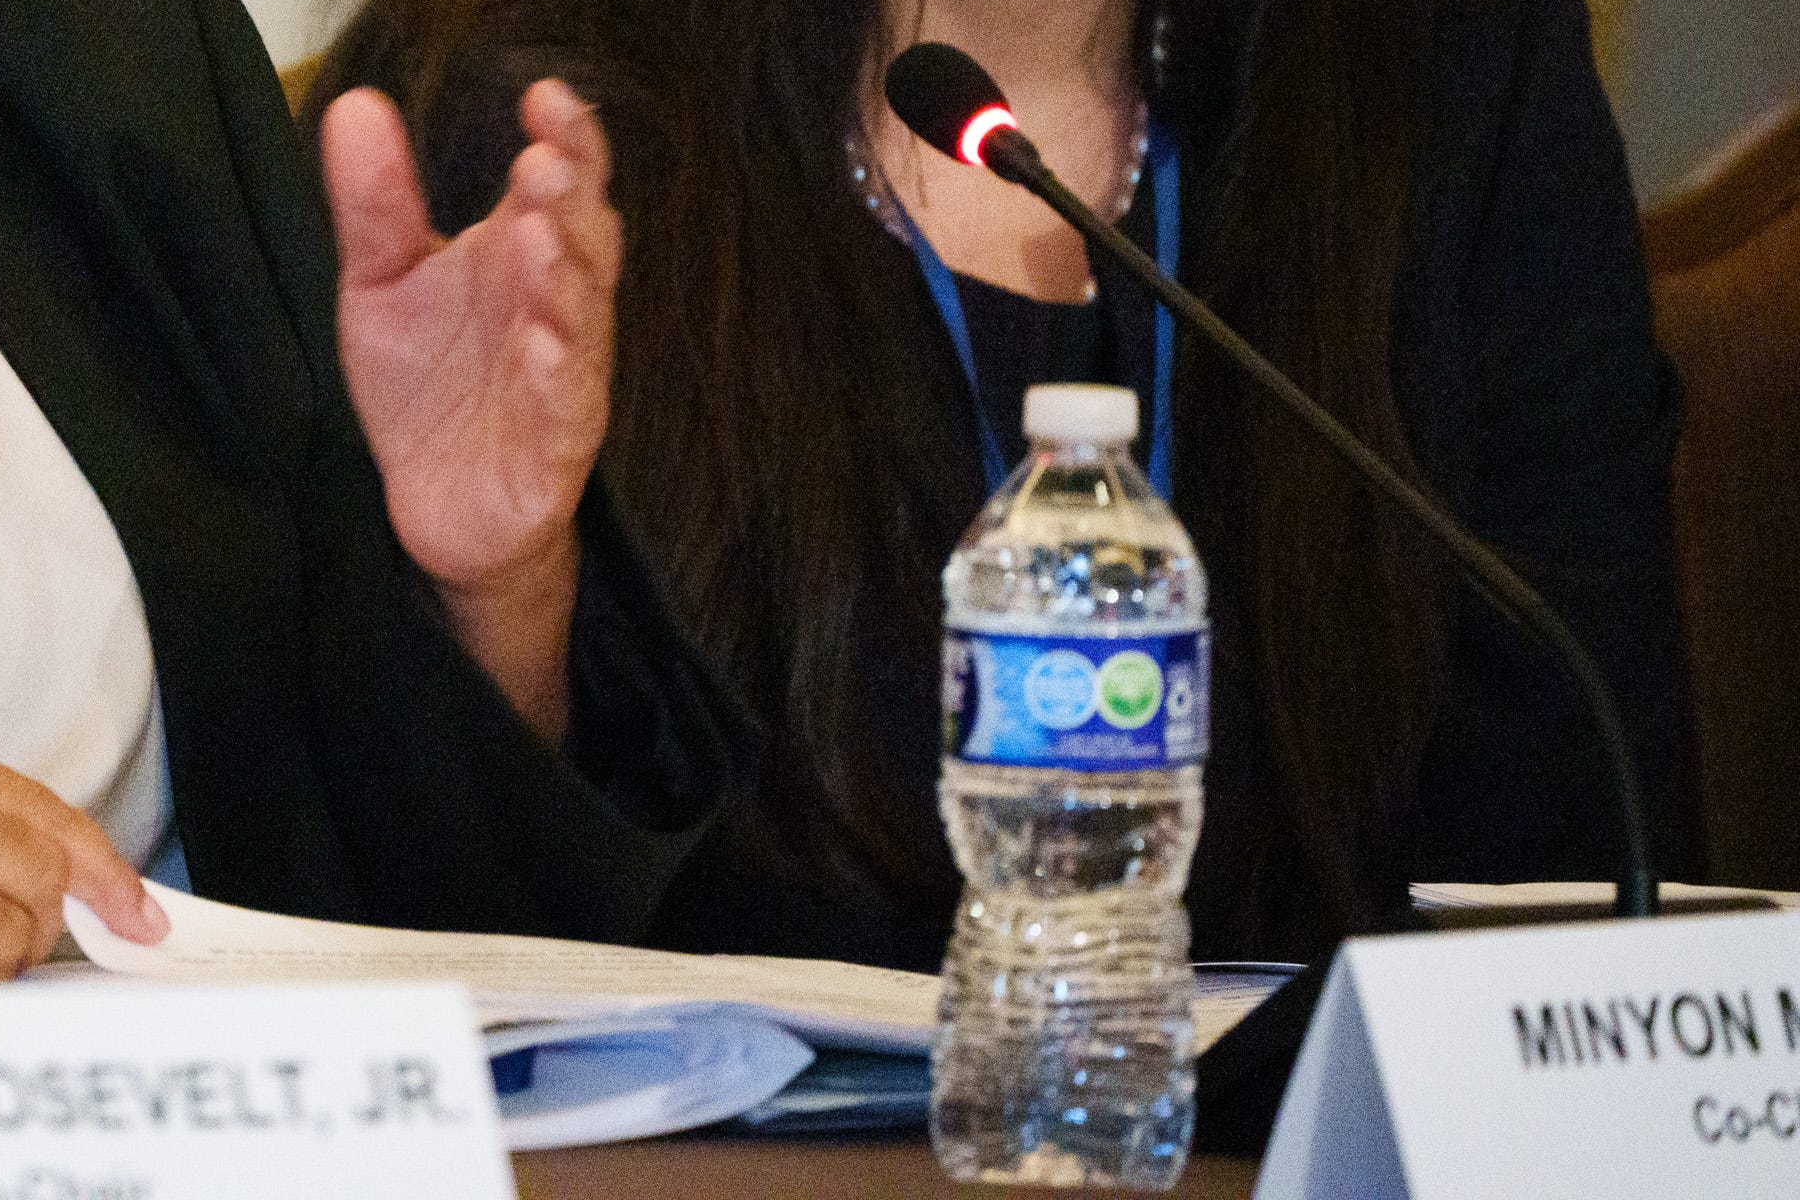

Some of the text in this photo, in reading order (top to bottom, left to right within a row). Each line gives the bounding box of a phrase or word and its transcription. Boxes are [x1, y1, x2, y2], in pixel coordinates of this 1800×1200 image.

[1509, 988, 1763, 1070] MINYON
[356, 1054, 471, 1127] JR.
[1691, 1086, 1800, 1146] Co-C
